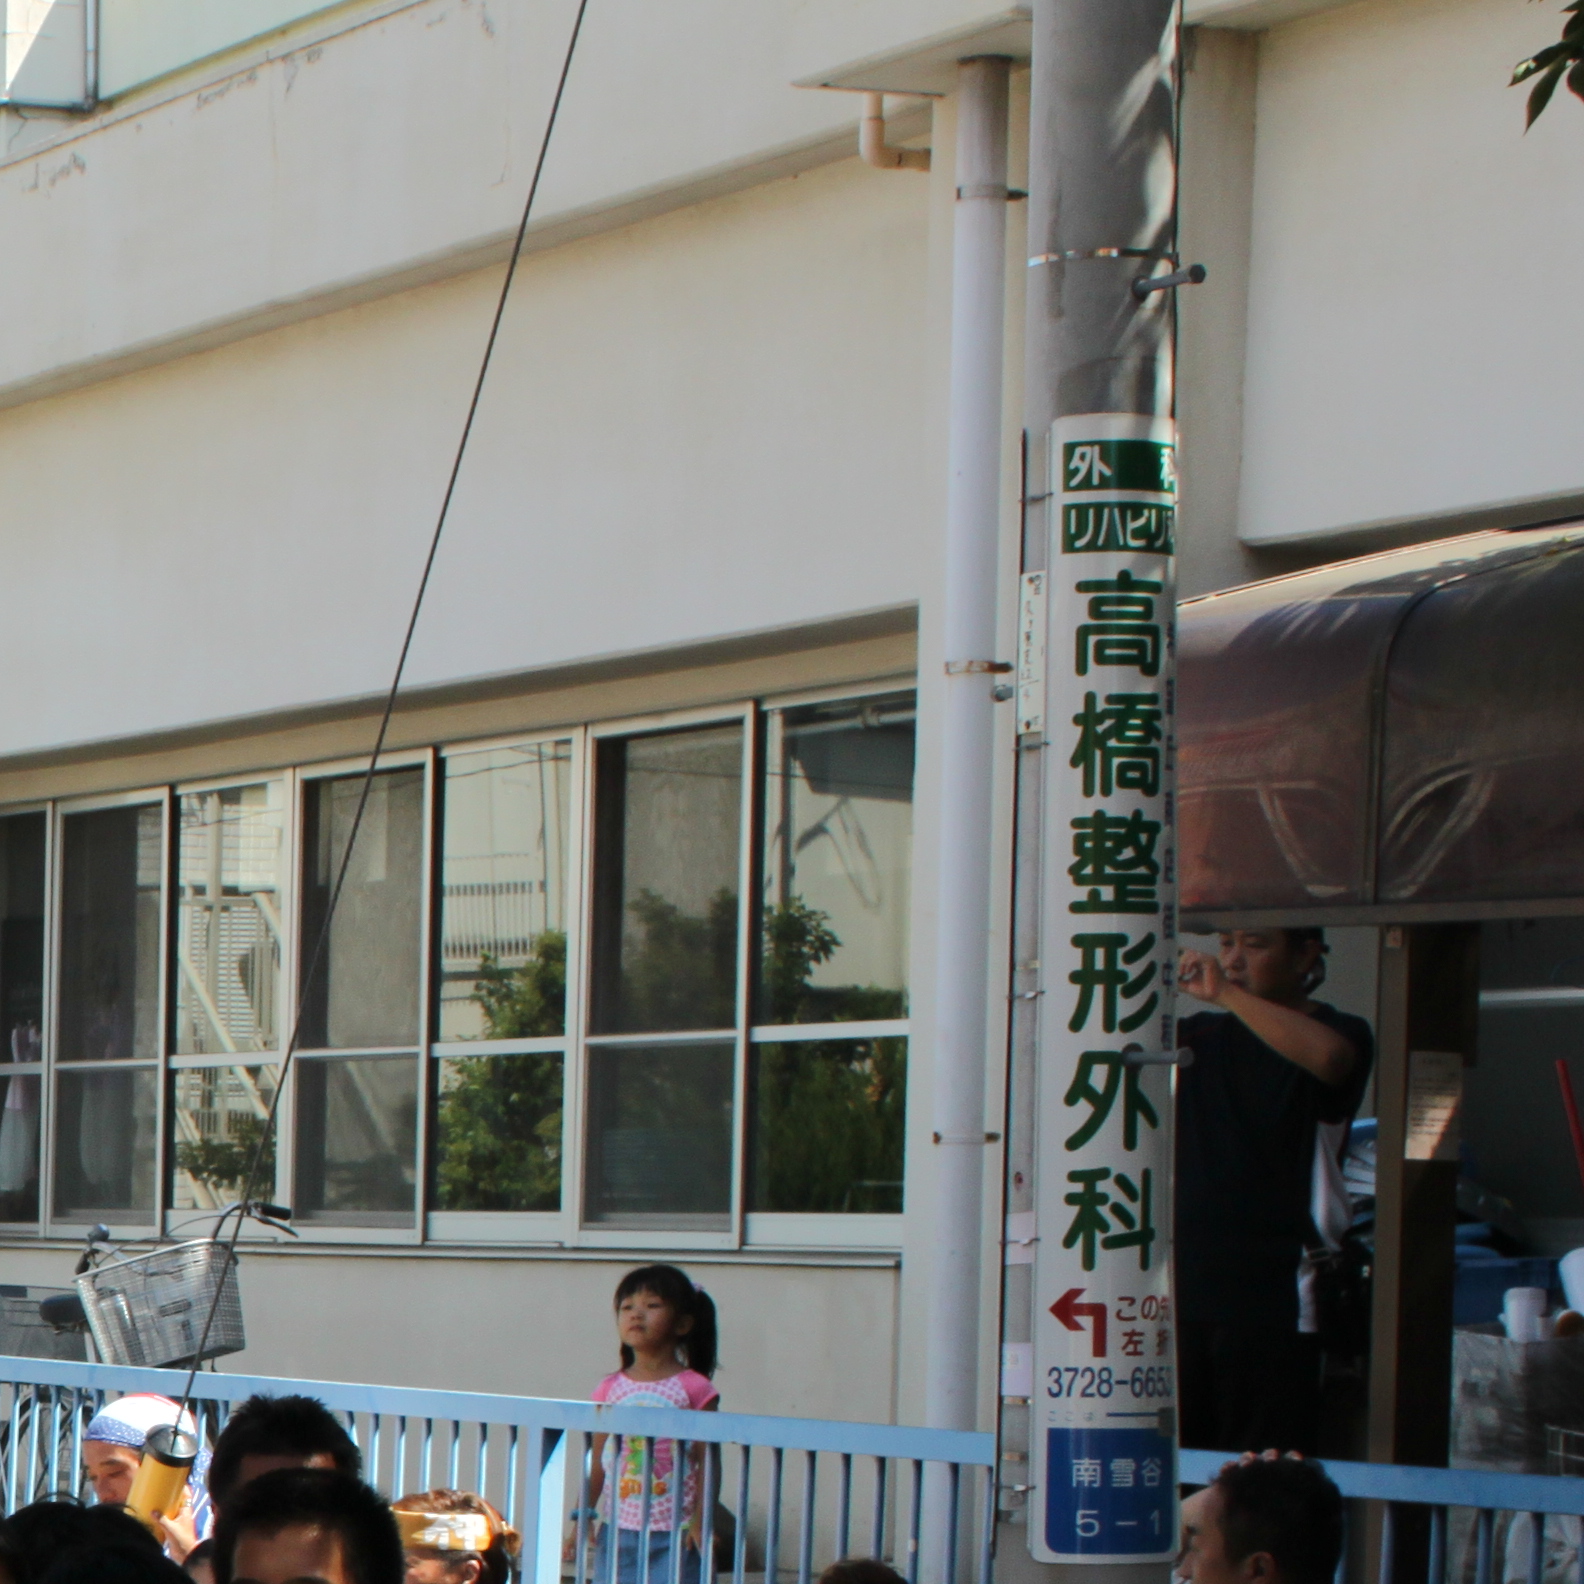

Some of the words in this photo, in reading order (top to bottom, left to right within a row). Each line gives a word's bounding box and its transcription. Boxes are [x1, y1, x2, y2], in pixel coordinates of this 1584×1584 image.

[1063, 569, 1163, 1272] 高橋整形外科
[1071, 1457, 1162, 1488] 南雪谷
